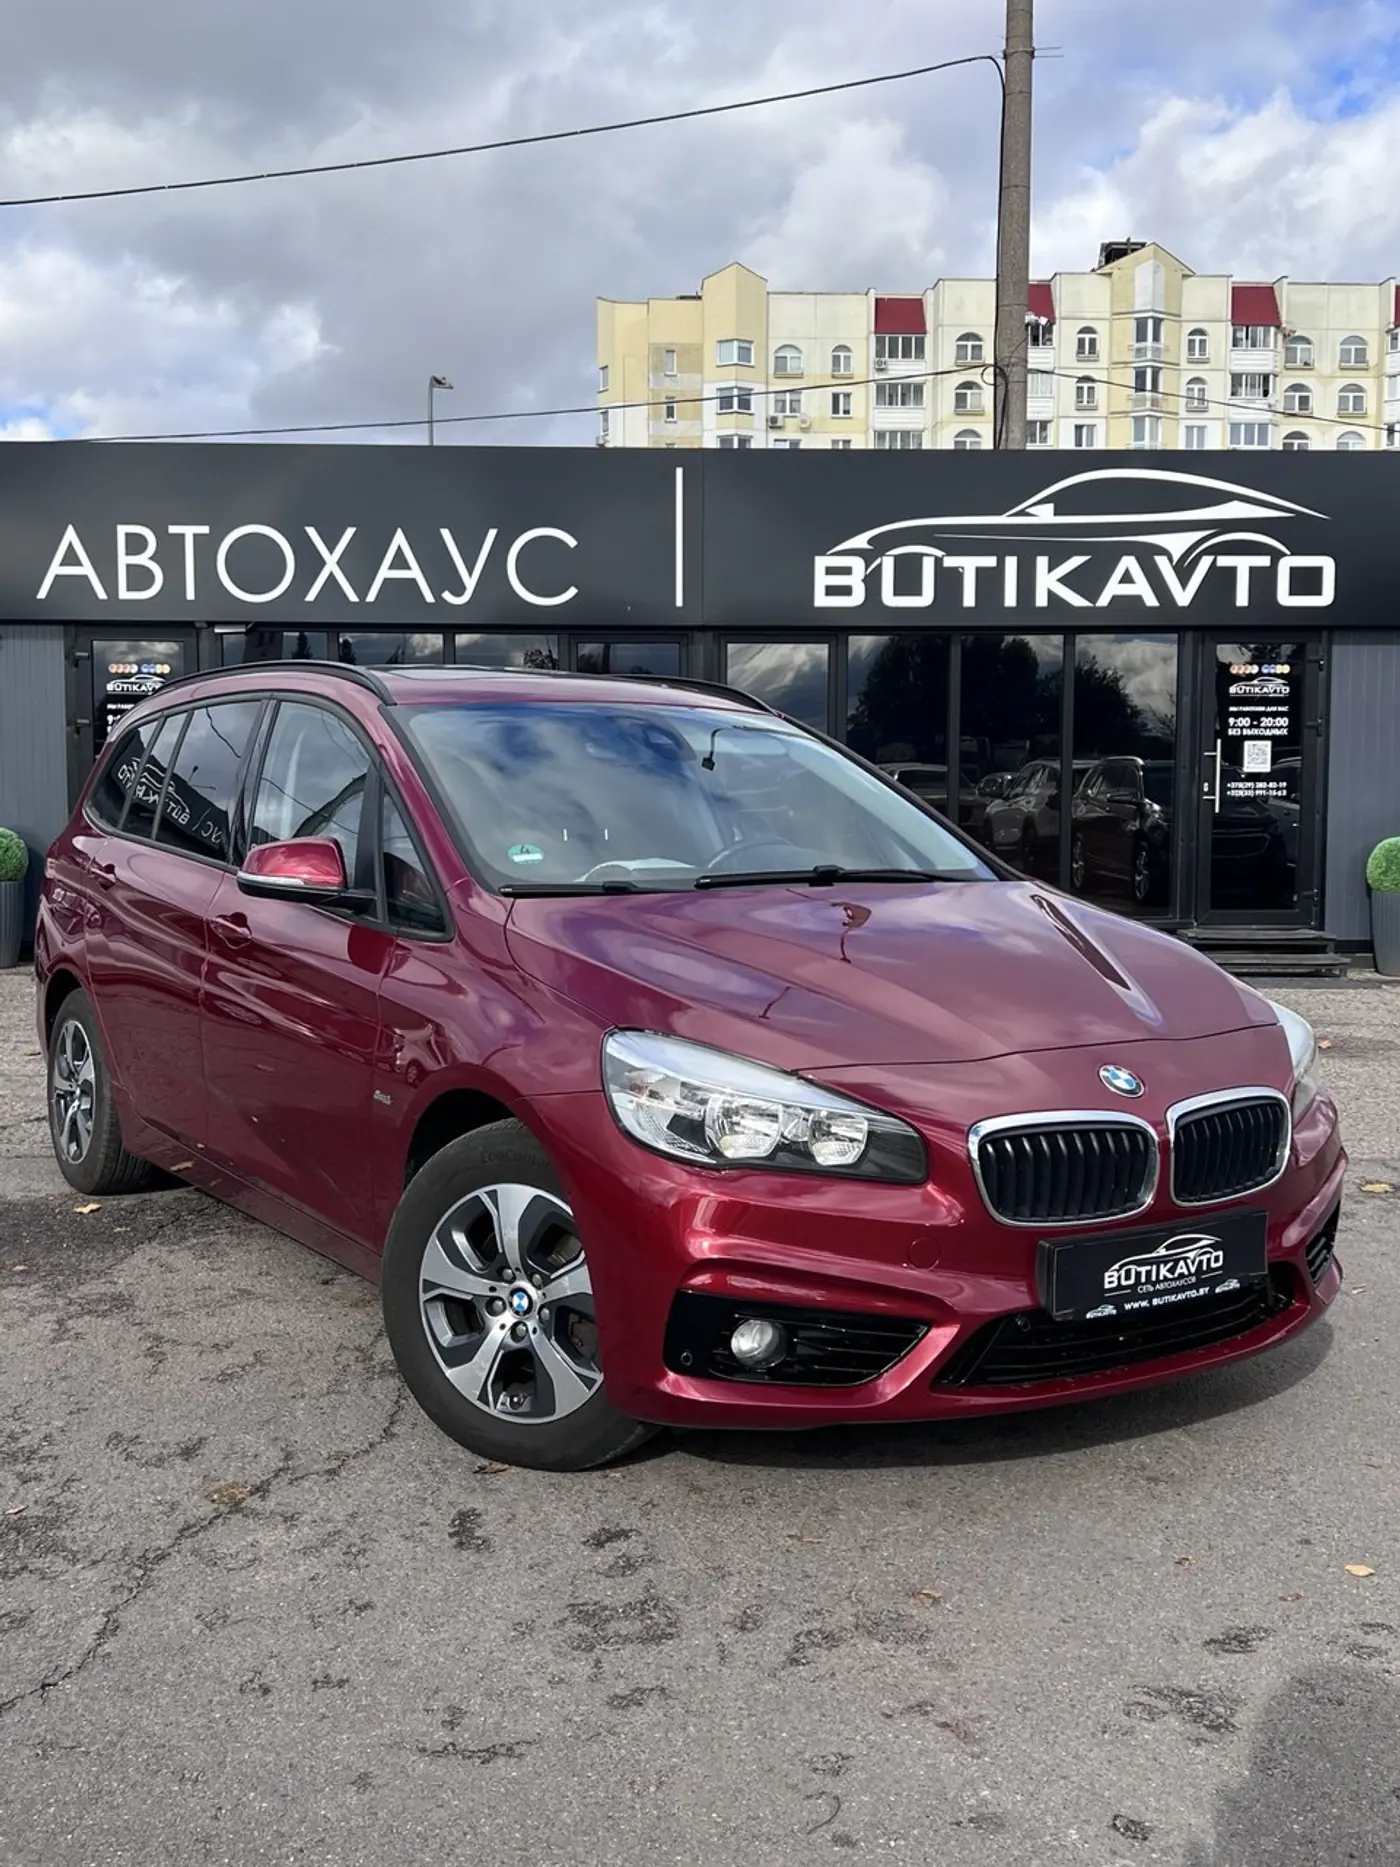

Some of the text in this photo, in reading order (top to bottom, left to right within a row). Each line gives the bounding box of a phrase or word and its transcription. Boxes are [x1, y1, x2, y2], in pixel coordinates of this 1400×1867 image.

[36, 523, 579, 607] АВТОХАУС
[813, 554, 1336, 608] BUTIKAVTO
[1228, 685, 1290, 694] BUTIKAVTO
[1228, 717, 1251, 727] 9:00
[1260, 717, 1289, 727] 20:00
[1103, 1250, 1223, 1289] BUTIKAVTO
